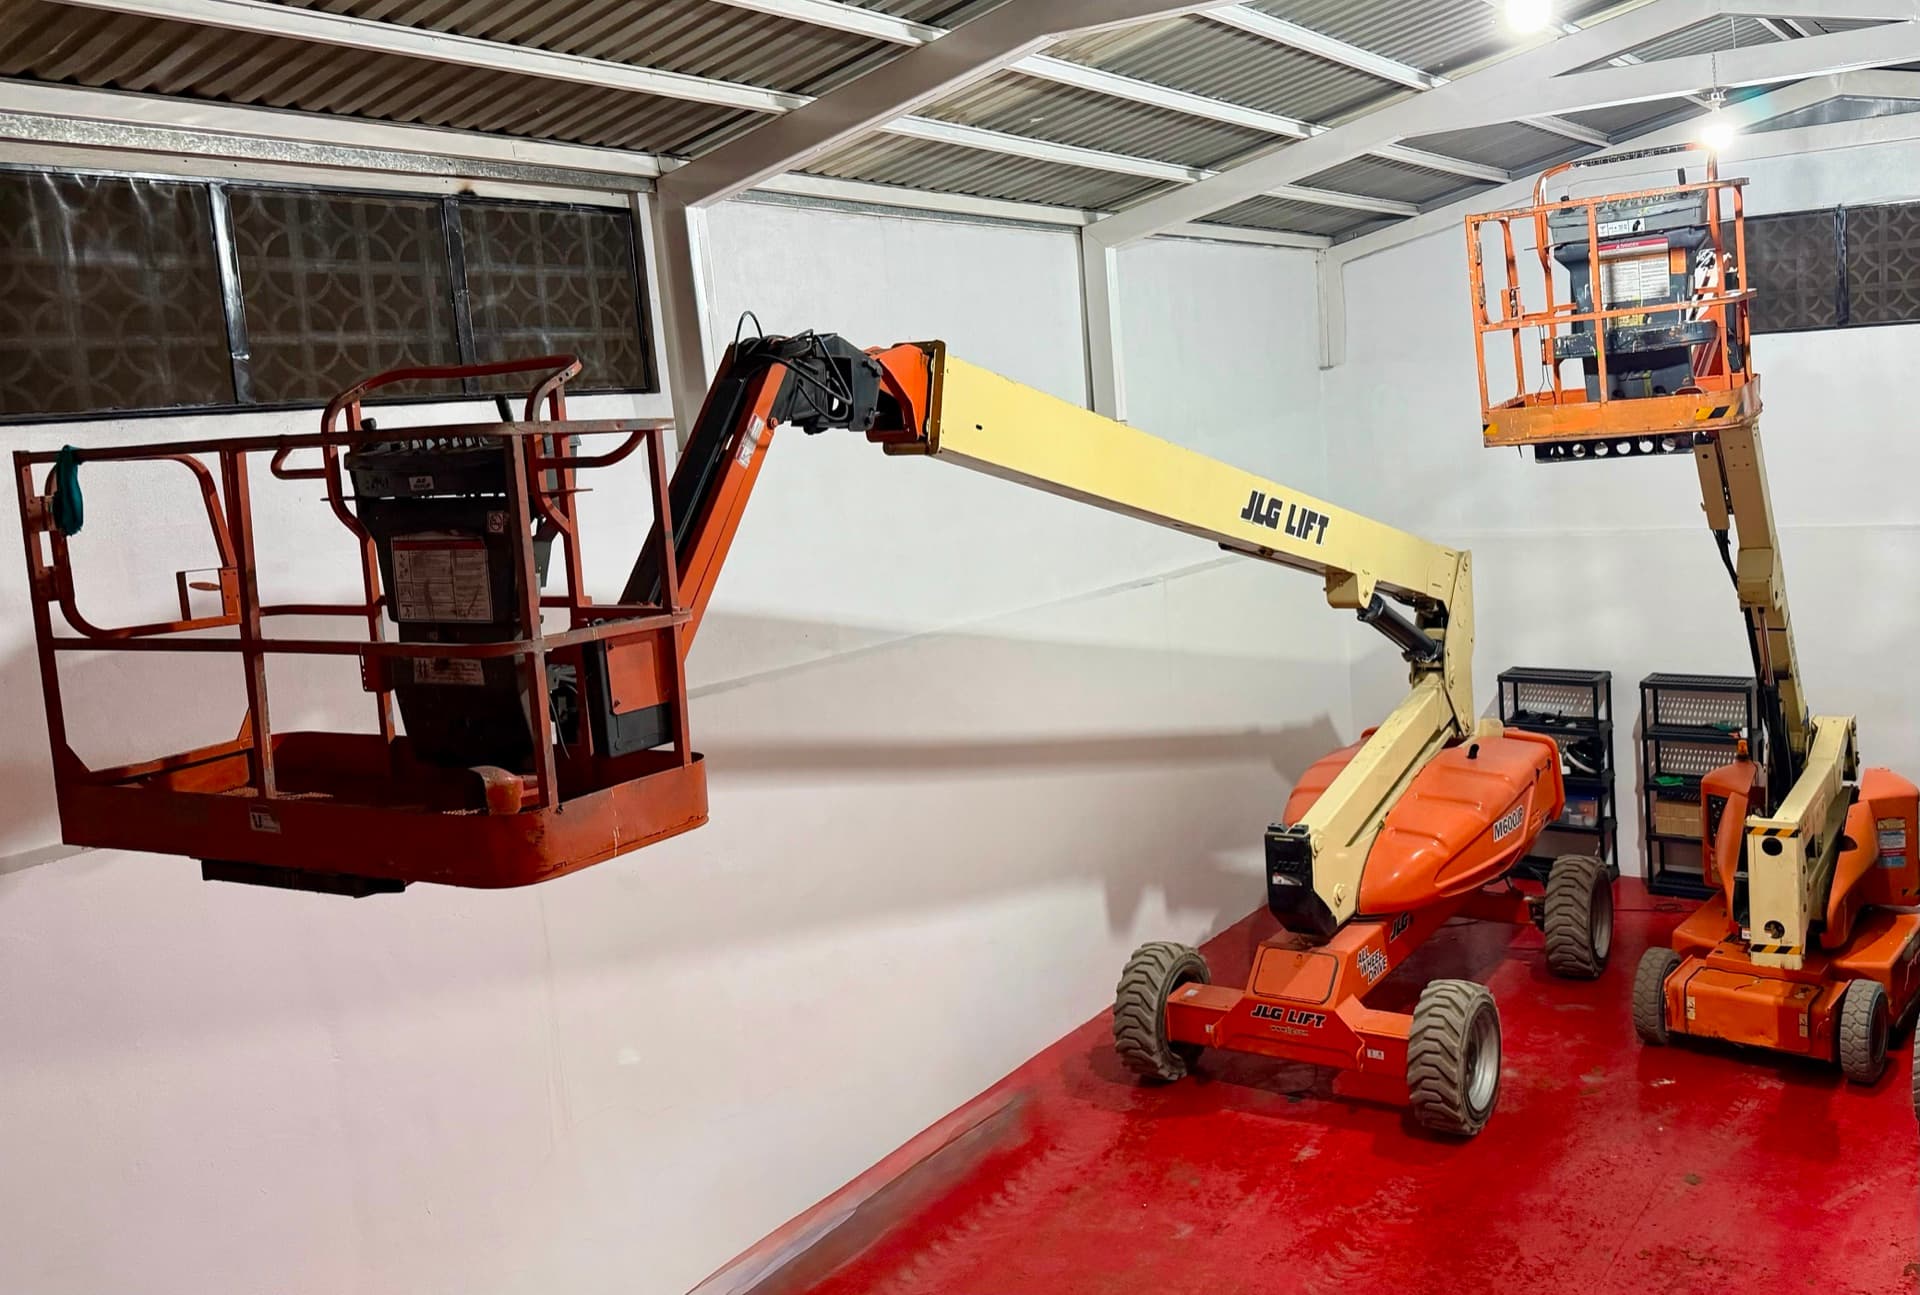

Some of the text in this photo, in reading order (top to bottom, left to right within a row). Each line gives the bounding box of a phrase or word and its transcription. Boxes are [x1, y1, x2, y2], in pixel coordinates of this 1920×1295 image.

[1241, 490, 1329, 544] JLG LIFT
[1389, 911, 1409, 943] JLG
[1251, 1004, 1326, 1028] JLG LIFT
